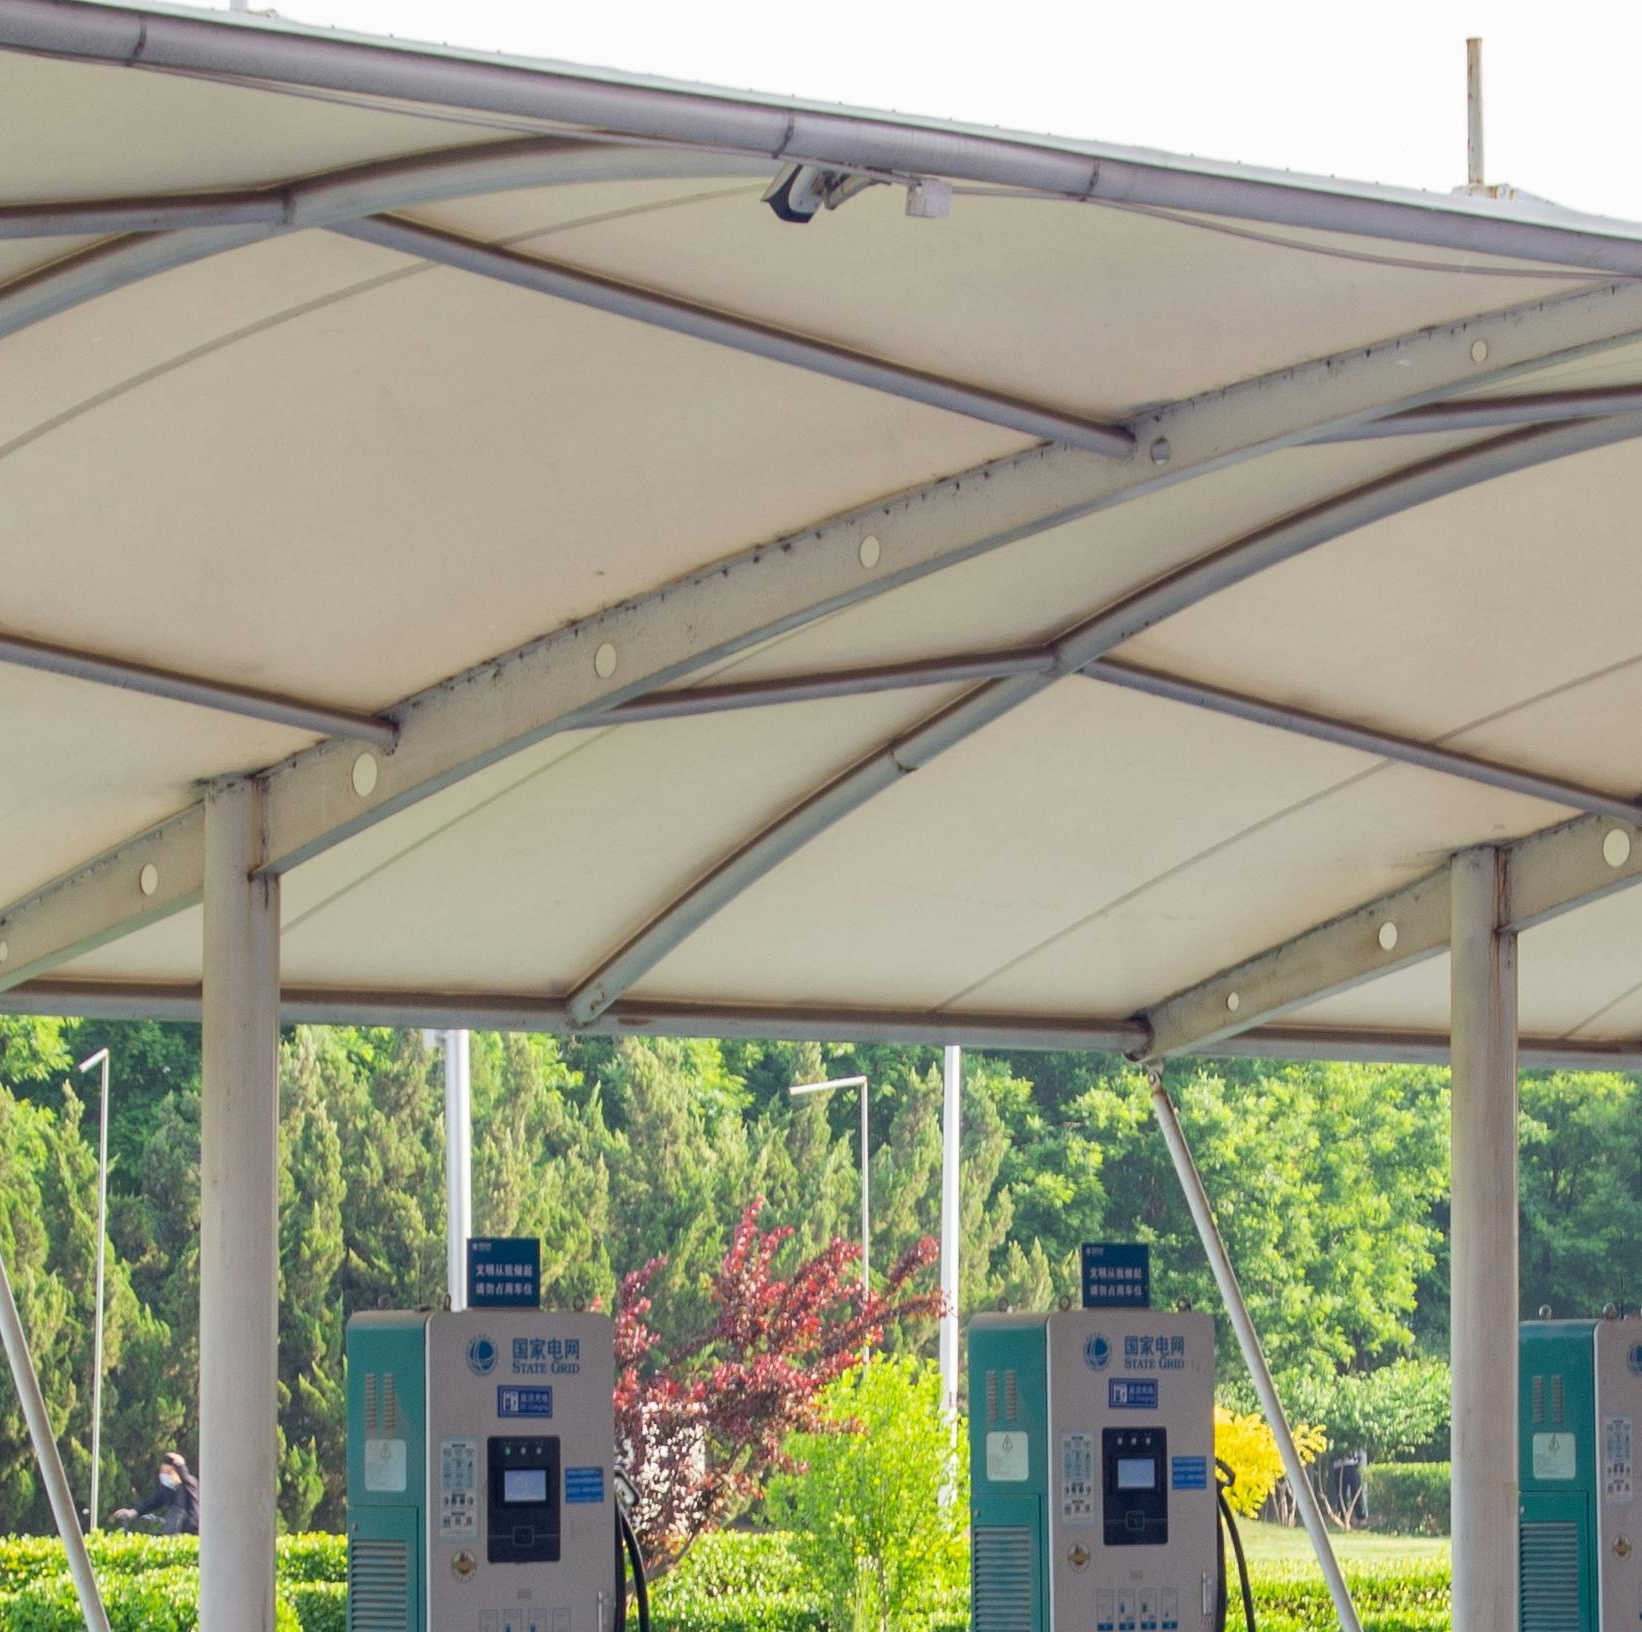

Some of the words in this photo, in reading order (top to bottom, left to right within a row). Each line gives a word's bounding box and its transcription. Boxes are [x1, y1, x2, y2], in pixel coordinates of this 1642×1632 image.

[512, 1337, 580, 1361] 国家电网
[1124, 1334, 1185, 1356] 国家电网
